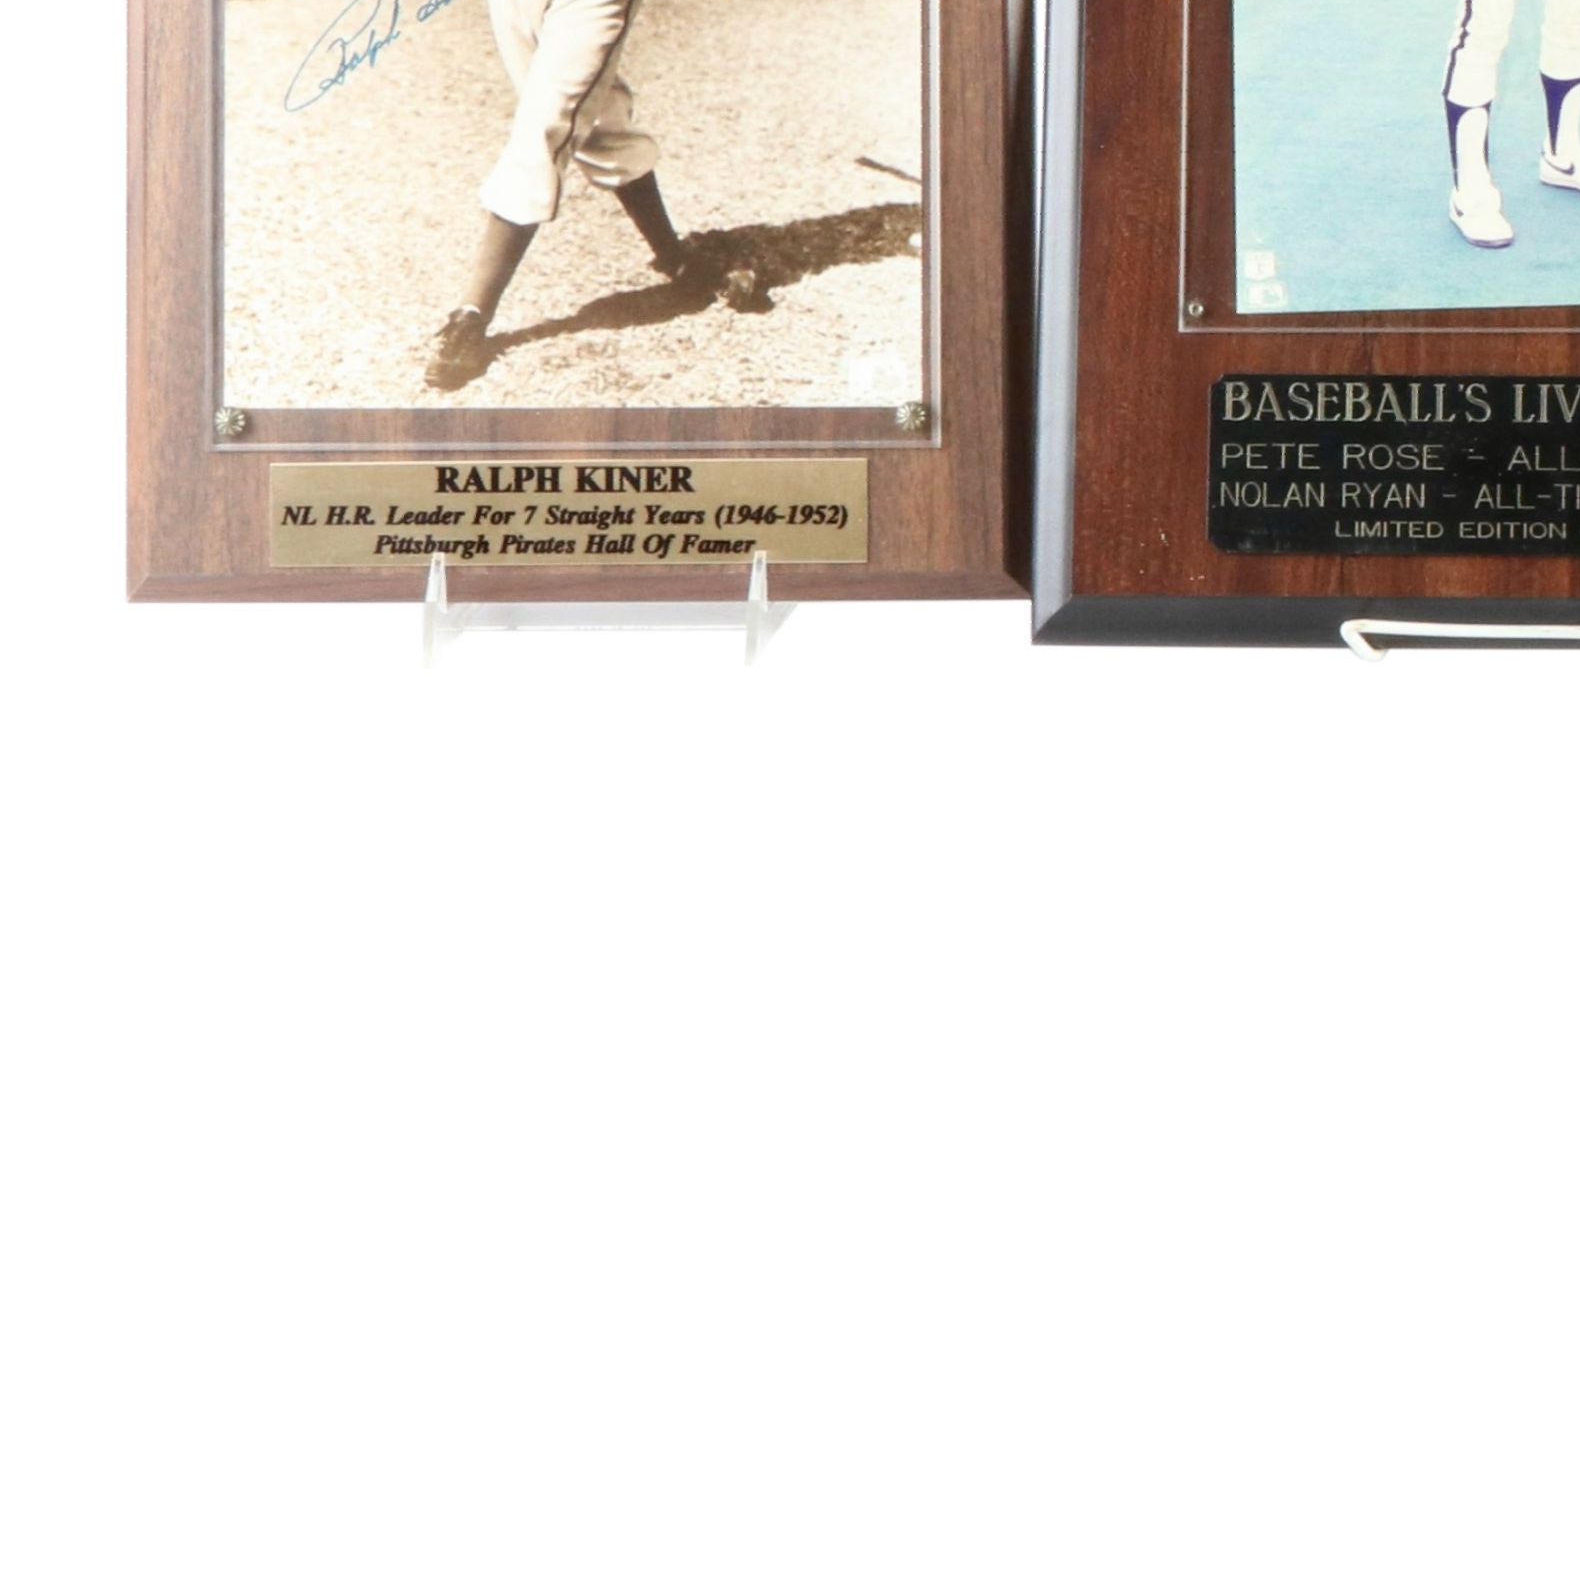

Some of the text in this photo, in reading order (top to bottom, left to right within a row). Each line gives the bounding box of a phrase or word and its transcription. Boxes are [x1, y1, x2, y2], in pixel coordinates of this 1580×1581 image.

[1222, 381, 1492, 424] BASEBALL'S
[1221, 442, 1321, 470] PETE
[1342, 444, 1445, 471] ROSE
[435, 465, 695, 494] RALPH KINER
[1219, 481, 1325, 508] NOLAN
[1341, 482, 1426, 509] RYAN
[282, 504, 849, 529] NL H.R. Leader For 7 Straight Years (1946-1952)
[1334, 520, 1444, 539] LIMITED
[1459, 521, 1567, 539] EDITION
[374, 534, 756, 558] Pittsburgh Pirates Hall Of Famer
